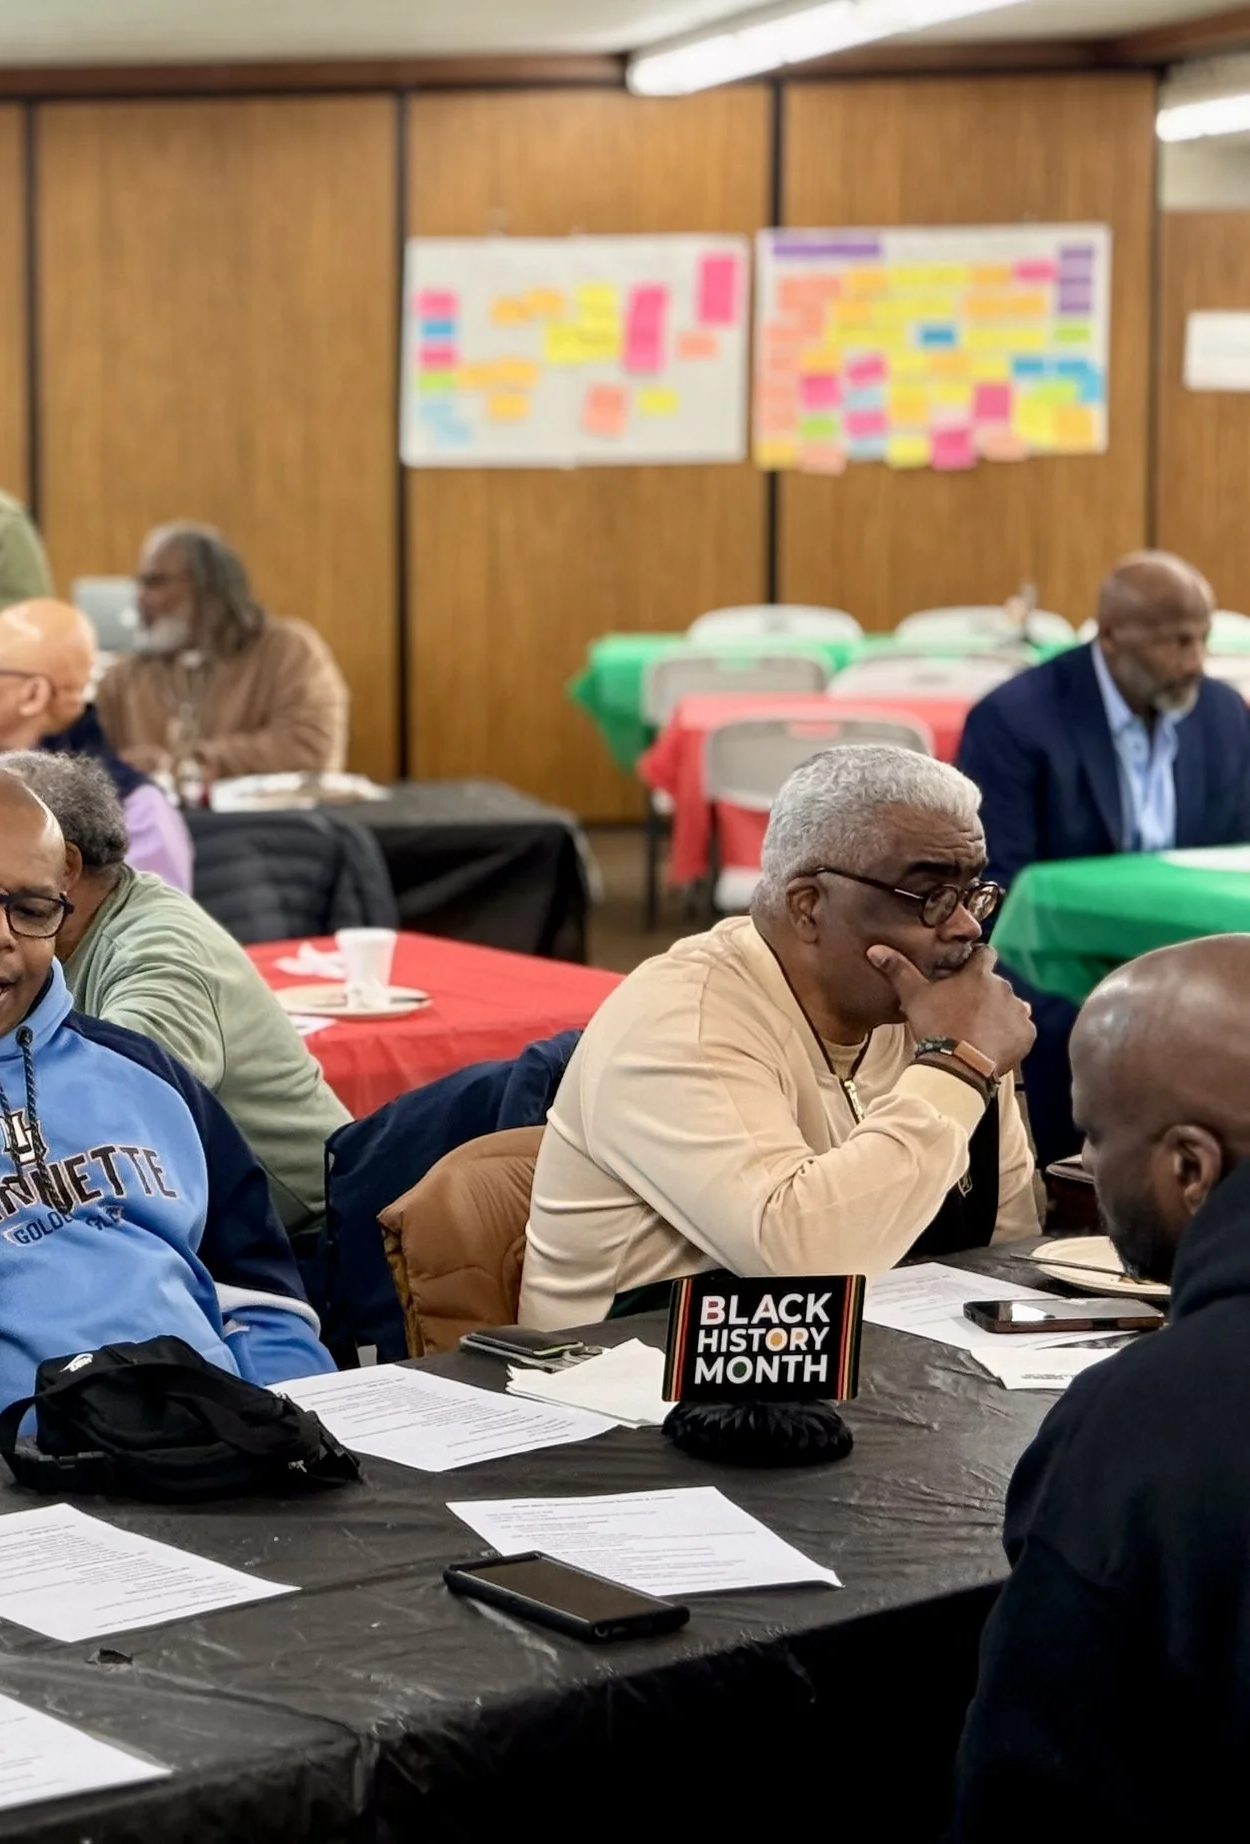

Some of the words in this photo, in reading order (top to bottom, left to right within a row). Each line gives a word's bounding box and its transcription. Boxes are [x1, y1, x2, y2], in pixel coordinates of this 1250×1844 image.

[13, 1211, 74, 1244] GOLD
[700, 1292, 832, 1326] BLACK
[697, 1326, 830, 1353] HISTORY
[694, 1354, 828, 1385] MONTH
